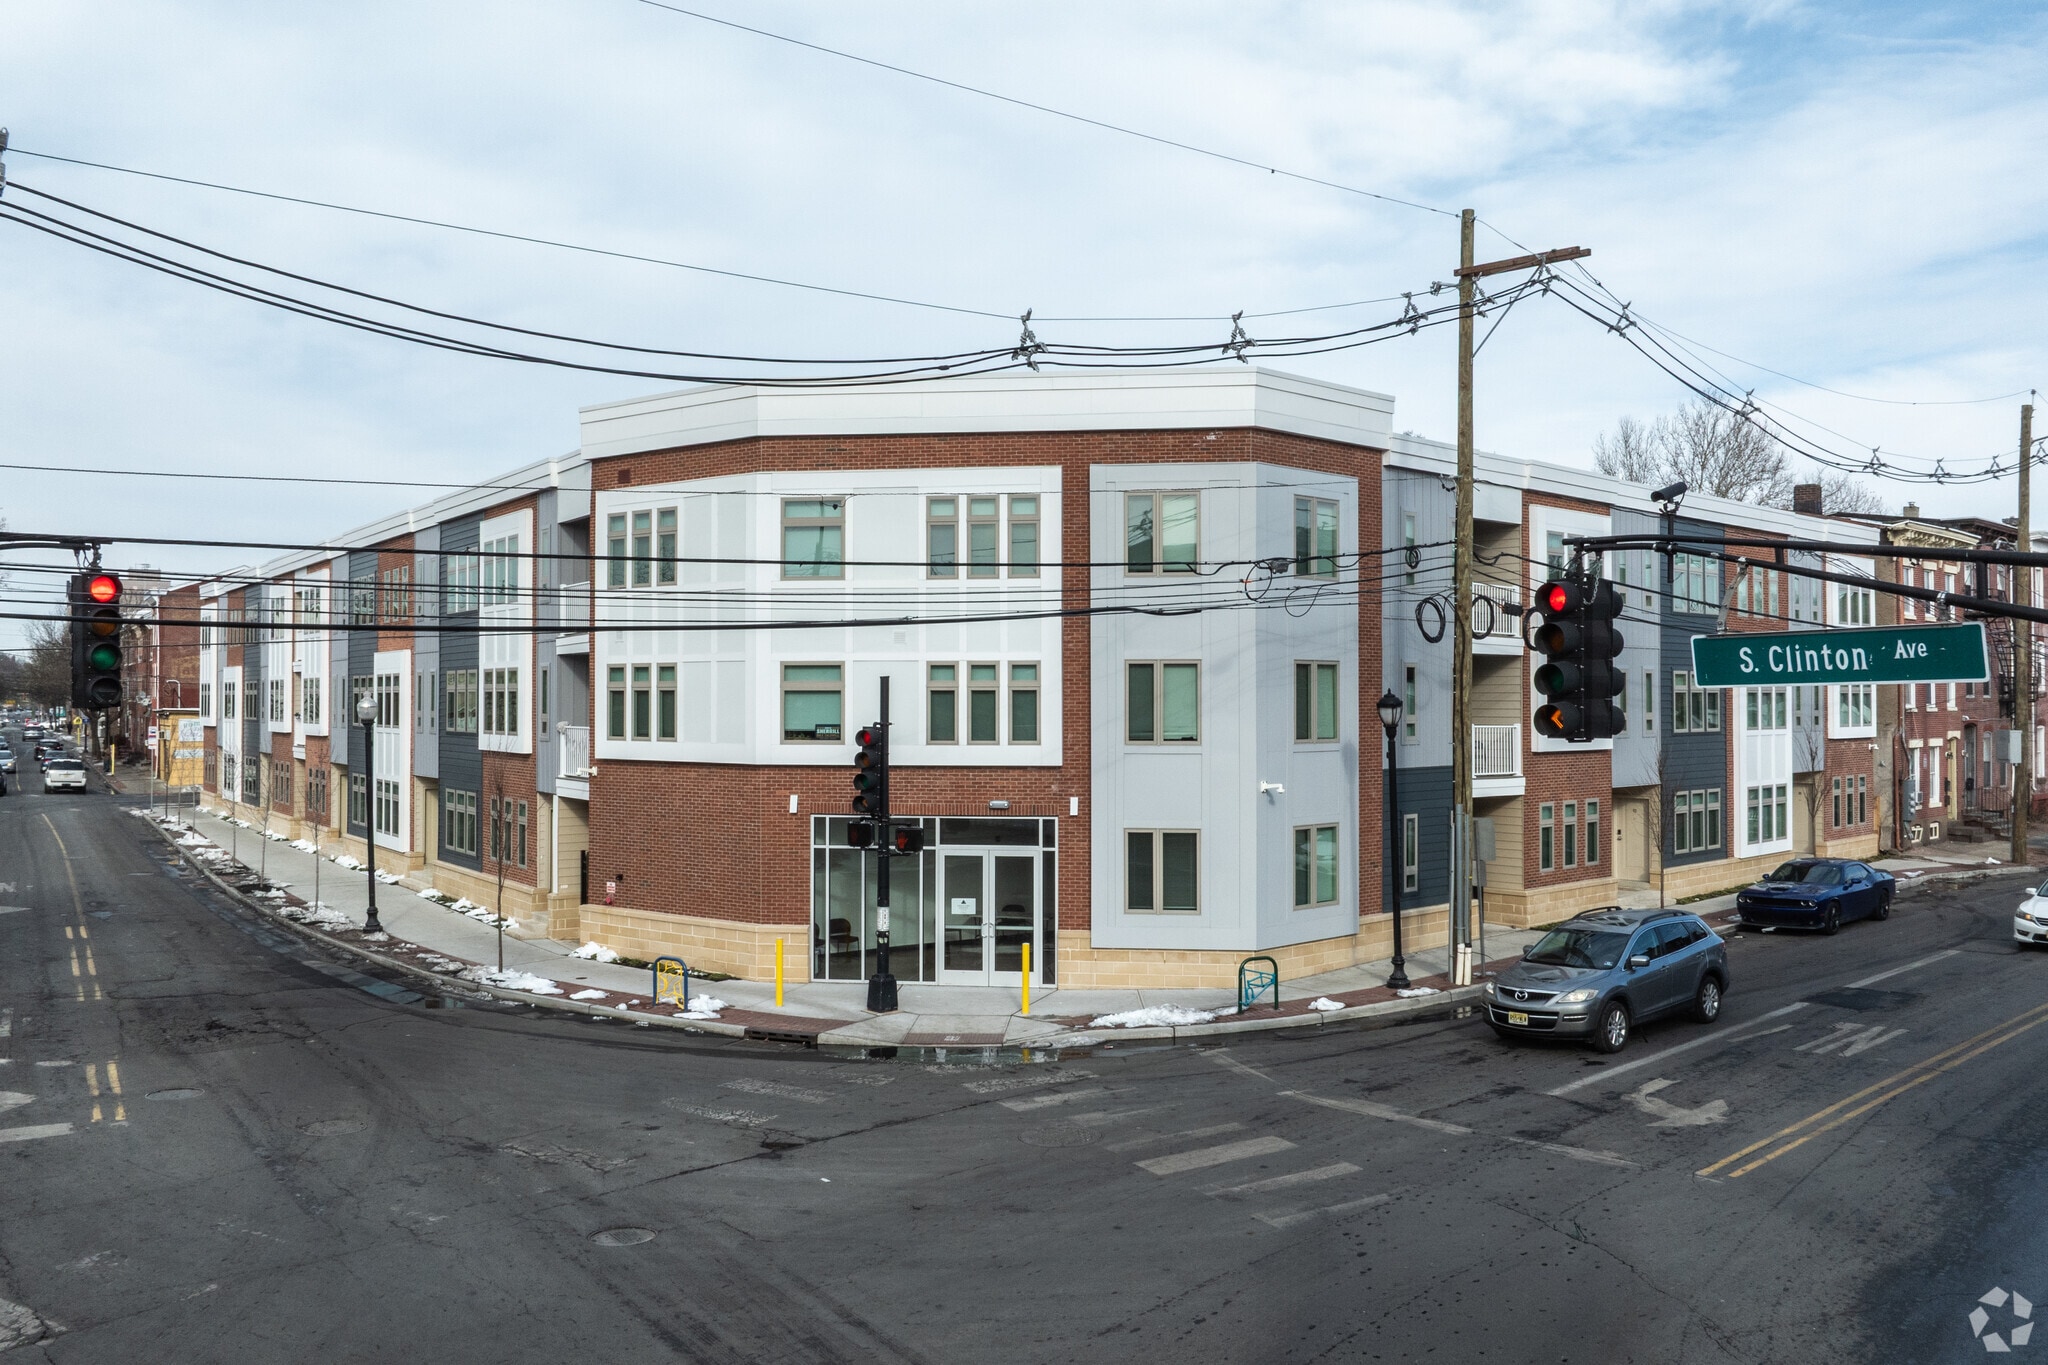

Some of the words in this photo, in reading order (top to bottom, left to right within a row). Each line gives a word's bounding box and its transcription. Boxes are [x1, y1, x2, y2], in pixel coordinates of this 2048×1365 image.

[1739, 647, 1759, 673] S.
[1768, 643, 1868, 672] Clinton
[1894, 639, 1928, 660] Ave
